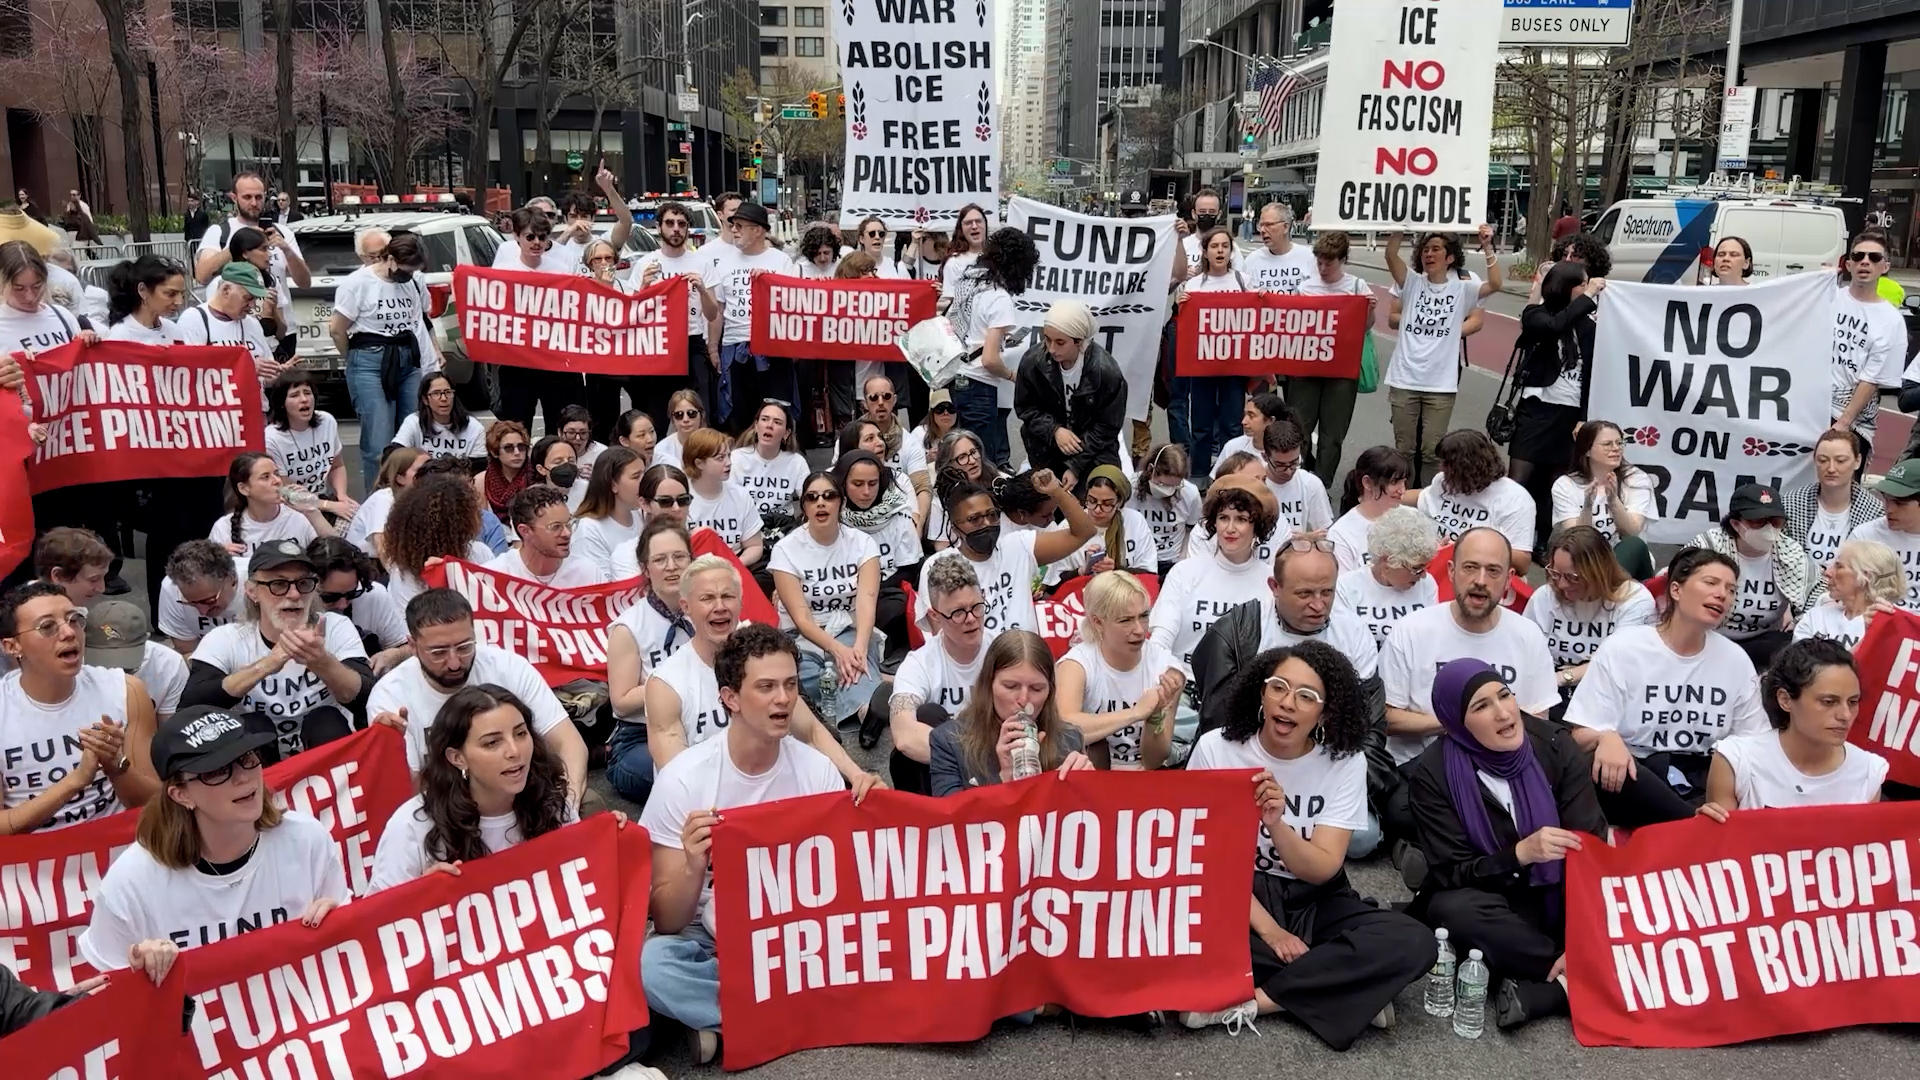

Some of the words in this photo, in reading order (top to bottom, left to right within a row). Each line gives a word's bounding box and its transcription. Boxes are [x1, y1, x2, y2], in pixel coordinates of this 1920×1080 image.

[876, 0, 955, 23] WAR
[1511, 18, 1562, 32] BUSES
[1569, 18, 1610, 32] ONLY
[1399, 7, 1438, 44] ICE
[847, 41, 990, 70] ABOLISH
[896, 75, 942, 103] ICE
[1383, 60, 1445, 91] NO
[1358, 94, 1462, 136] FASCISM
[883, 120, 960, 150] FREE
[853, 155, 992, 195] PALESTINE
[1375, 147, 1438, 176] NO
[1339, 180, 1471, 225] GENOCIDE
[1027, 216, 1155, 264] FUND
[1624, 215, 1672, 240] Spectrum
[1259, 279, 1302, 288] PEOPLE
[1261, 267, 1301, 278] FUND
[377, 297, 413, 309] FUND
[467, 275, 507, 311] NO
[514, 283, 580, 321] WAR
[585, 292, 623, 327] NO
[629, 294, 668, 326] ICE
[769, 285, 829, 316] FUND
[832, 289, 910, 320] PEOPLE
[1415, 301, 1454, 317] PEOPLE
[1419, 290, 1454, 307] FUND
[376, 311, 413, 321] PEOPL
[1198, 308, 1257, 333] FUND
[1260, 308, 1339, 335] PEOPLE
[1414, 314, 1448, 327] NOT
[1664, 300, 1763, 358] NO
[1836, 313, 1869, 336] UND
[20, 331, 67, 350] FUN
[466, 309, 526, 346] FREE
[531, 320, 669, 356] PALESTINE
[769, 313, 818, 343] NOT
[821, 318, 910, 347] BOMBS
[1405, 324, 1451, 338] BOMBS
[1198, 334, 1246, 361] NOT
[1249, 333, 1337, 362] BOMBS
[72, 362, 151, 406] WAR
[152, 365, 191, 407] NO
[195, 367, 243, 407] ICE
[1627, 353, 1792, 422] WAR
[100, 408, 247, 451] PALESTINE
[422, 436, 467, 450] FUND
[286, 441, 331, 466] FUND
[1671, 427, 1731, 460] ON
[287, 456, 334, 477] PEOPLE
[742, 477, 790, 489] FUND
[748, 490, 791, 501] EOPLE
[1633, 463, 1783, 523] RA
[1441, 500, 1489, 522] FUND
[1810, 532, 1841, 547] UN
[803, 563, 859, 582] FUND
[803, 584, 858, 598] PEOPL
[1743, 579, 1776, 596] ND
[506, 580, 602, 624] WAR
[474, 618, 549, 665] REE
[1552, 618, 1617, 639] FUND
[1547, 637, 1600, 656] PEOP
[260, 671, 320, 696] UND
[1645, 684, 1728, 706] FUND
[243, 686, 331, 716] PEOPLE
[1641, 709, 1727, 729] PEOPLE
[4, 734, 85, 770] FUN
[1652, 729, 1712, 749] NOT
[1282, 794, 1325, 818] ND
[746, 834, 838, 921] NO
[852, 821, 1008, 903] WAR
[1018, 809, 1102, 888] NO
[1116, 807, 1209, 882] ICE
[1601, 857, 1751, 939] FUND
[1751, 837, 1920, 919] PEOPL
[752, 909, 894, 1004] FREE
[907, 886, 1203, 981] PALESTINE
[191, 938, 376, 1071] FUND
[377, 856, 606, 994] PEOPLE
[1611, 930, 1740, 1013] NOT
[1746, 908, 1920, 995] BOMB
[366, 928, 617, 1080] BOMBS
